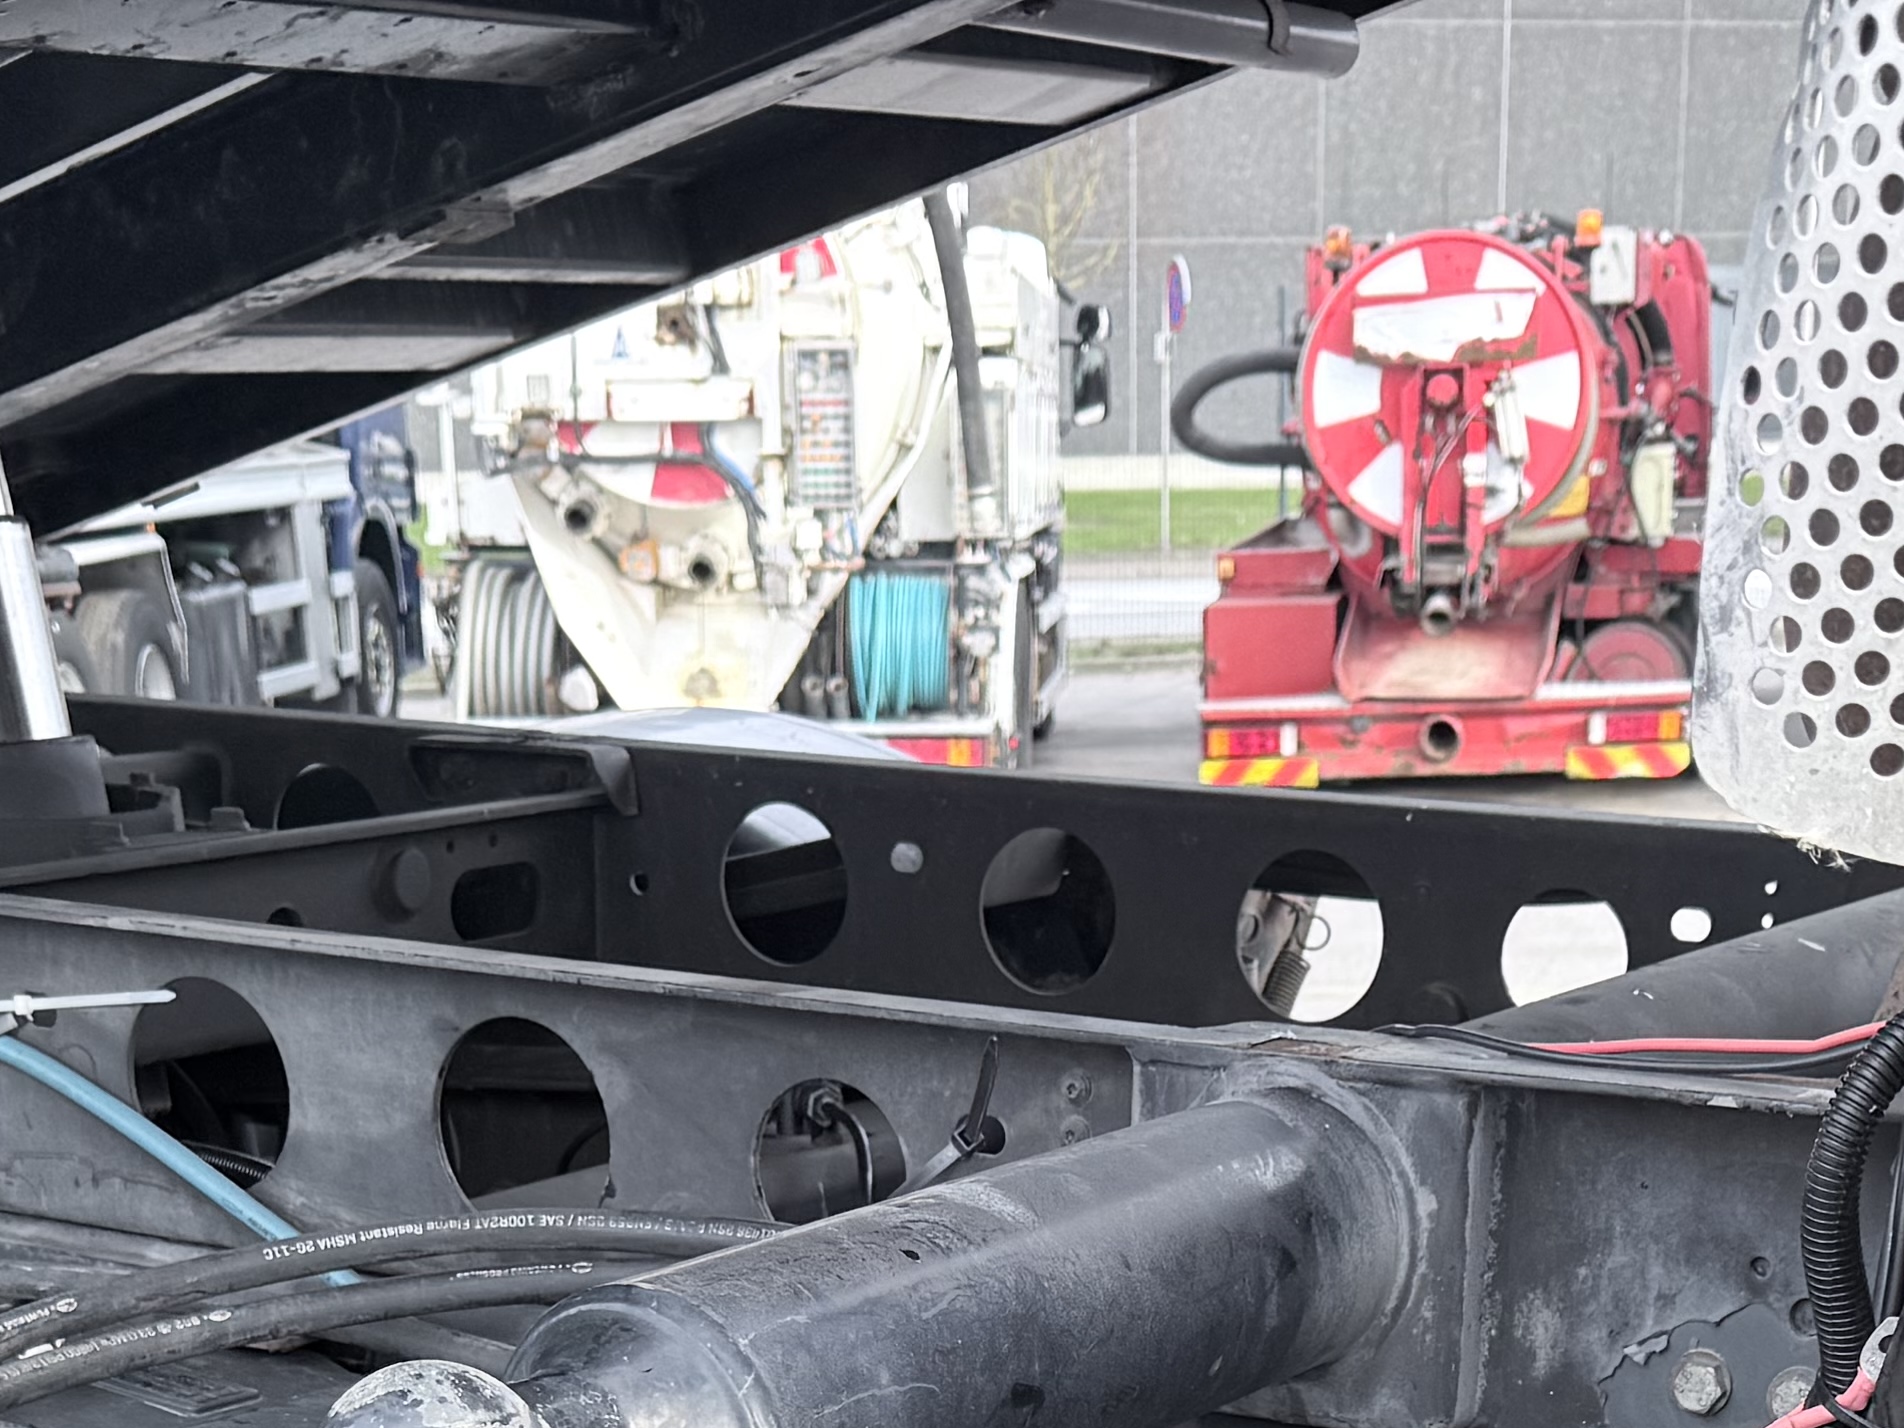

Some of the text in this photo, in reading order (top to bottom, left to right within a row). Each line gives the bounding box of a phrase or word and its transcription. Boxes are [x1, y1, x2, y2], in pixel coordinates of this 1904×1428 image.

[427, 1217, 470, 1232] Flame
[474, 1213, 534, 1229] 100R2AT
[538, 1213, 565, 1227] SAE
[360, 1223, 423, 1242] Resistant
[317, 1233, 357, 1249] MSHA
[262, 1240, 315, 1260] 2G-11C
